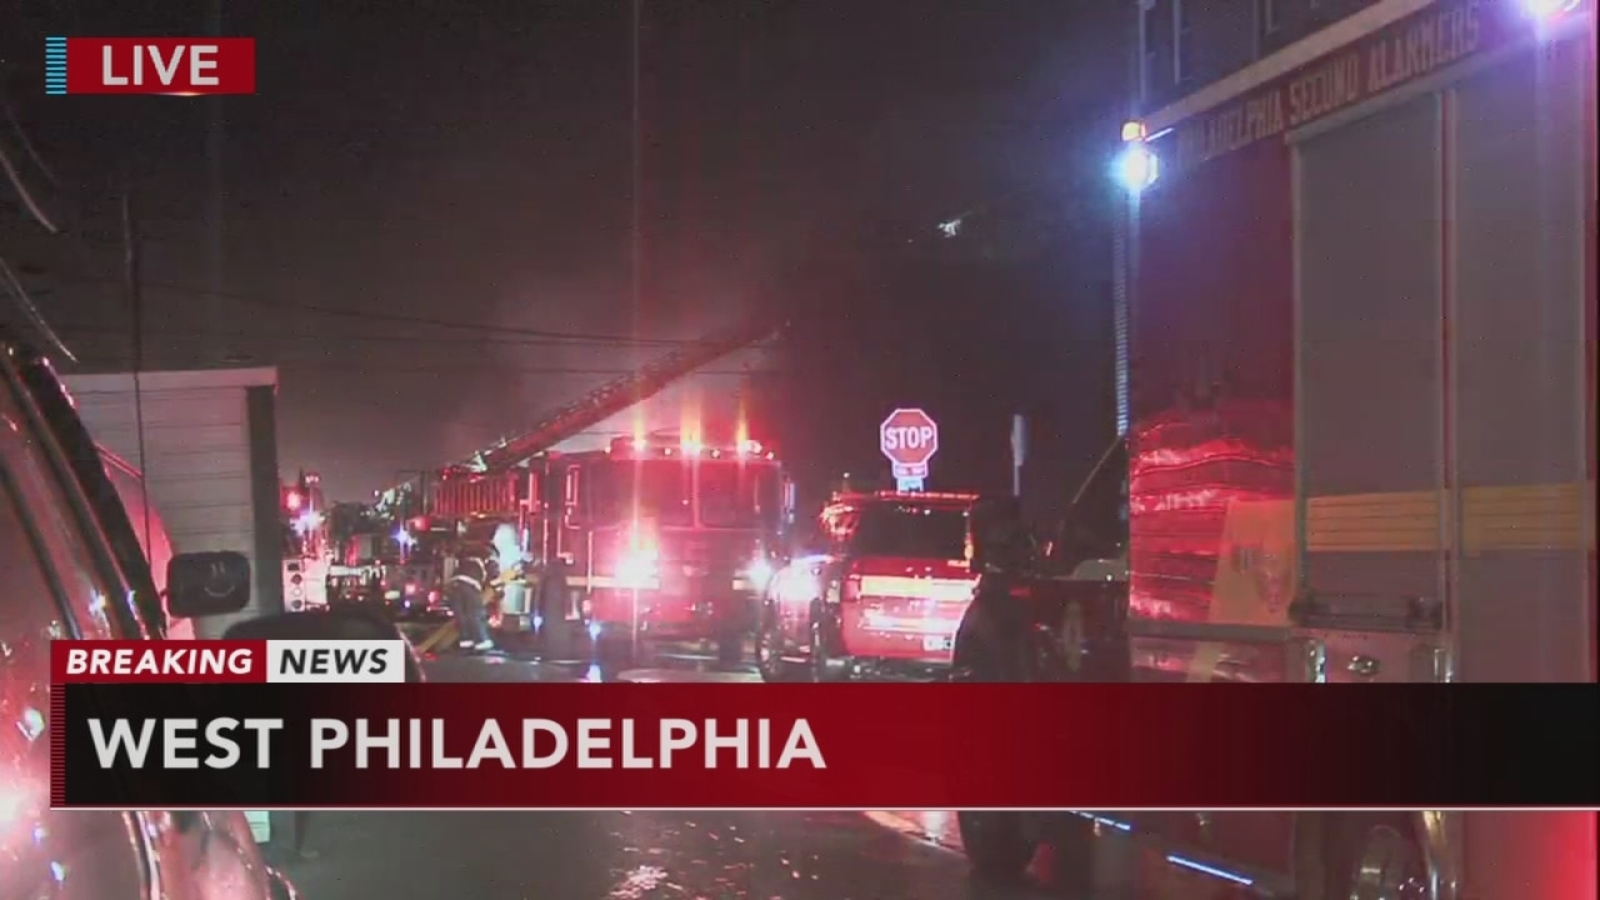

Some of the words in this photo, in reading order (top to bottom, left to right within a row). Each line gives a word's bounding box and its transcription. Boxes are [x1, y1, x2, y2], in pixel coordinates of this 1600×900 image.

[1177, 89, 1285, 168] LADELPHIA
[1289, 55, 1360, 121] SECOND
[885, 426, 932, 450] STOP
